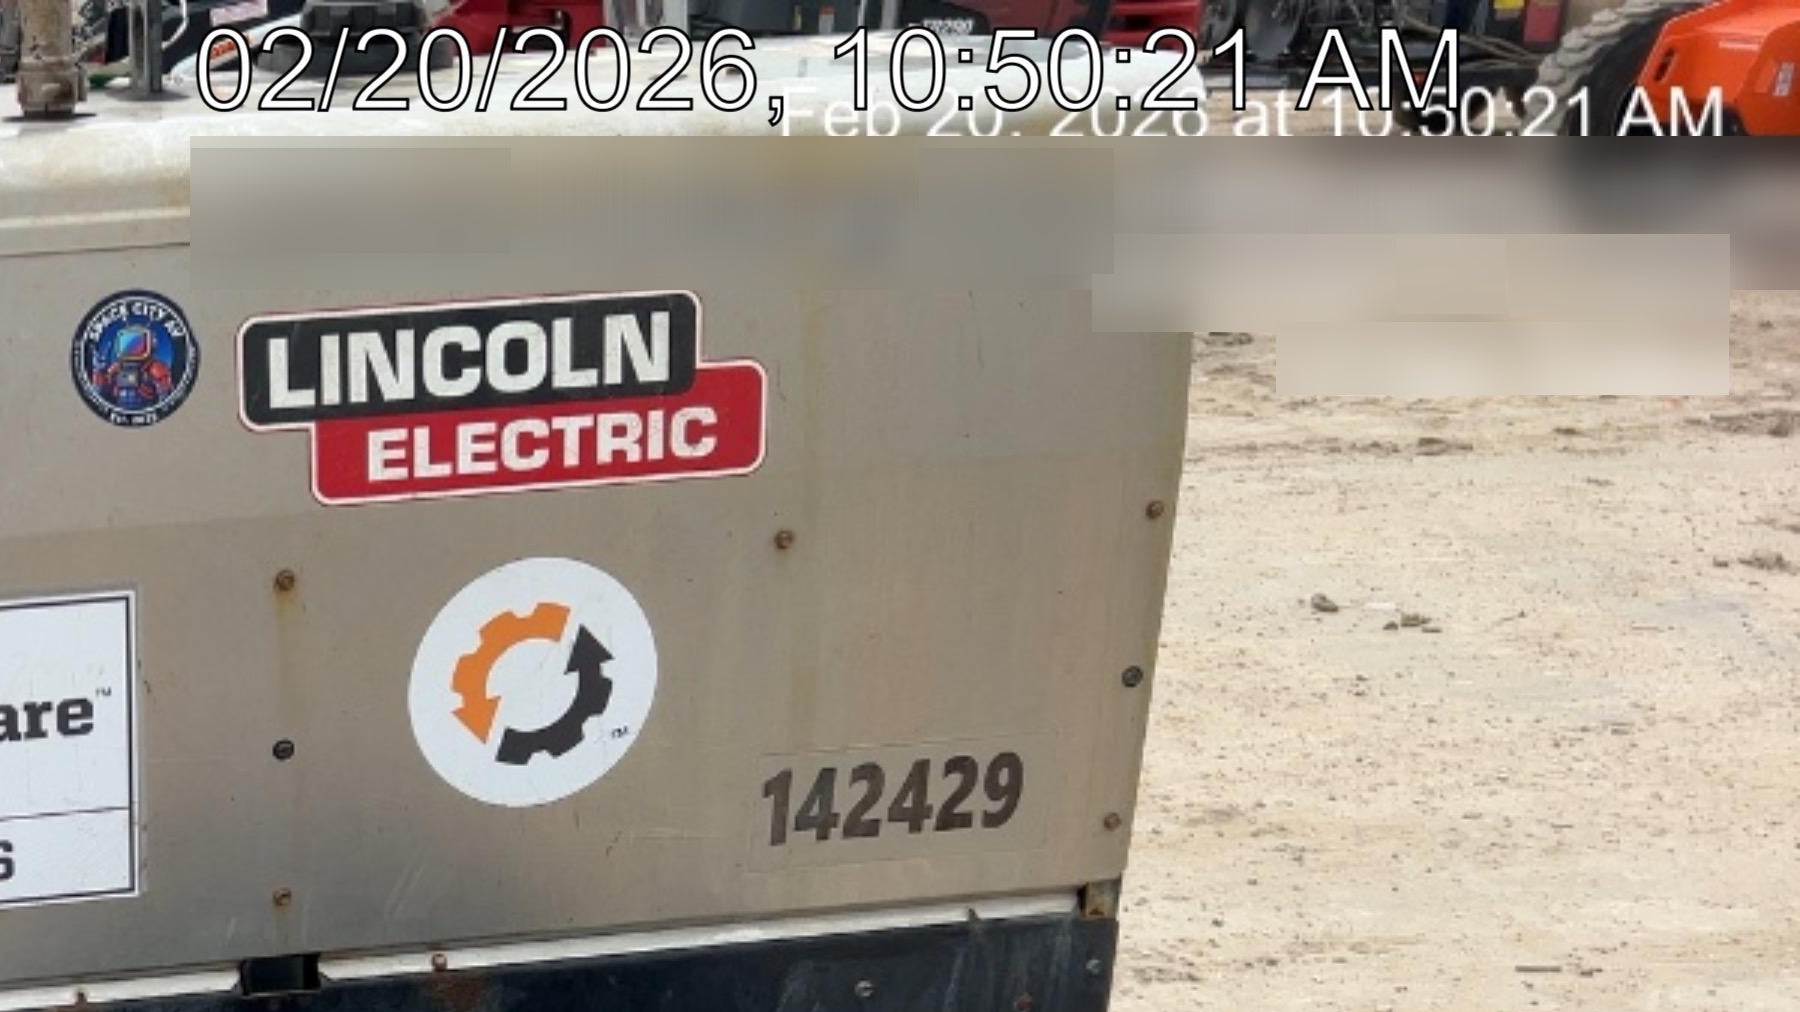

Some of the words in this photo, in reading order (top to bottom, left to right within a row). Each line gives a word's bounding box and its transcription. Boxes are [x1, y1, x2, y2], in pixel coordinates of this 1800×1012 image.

[131, 301, 168, 321] CITY
[267, 312, 670, 408] LINCOLN
[367, 406, 719, 482] ELECTRIC
[762, 751, 1024, 847] 142429
